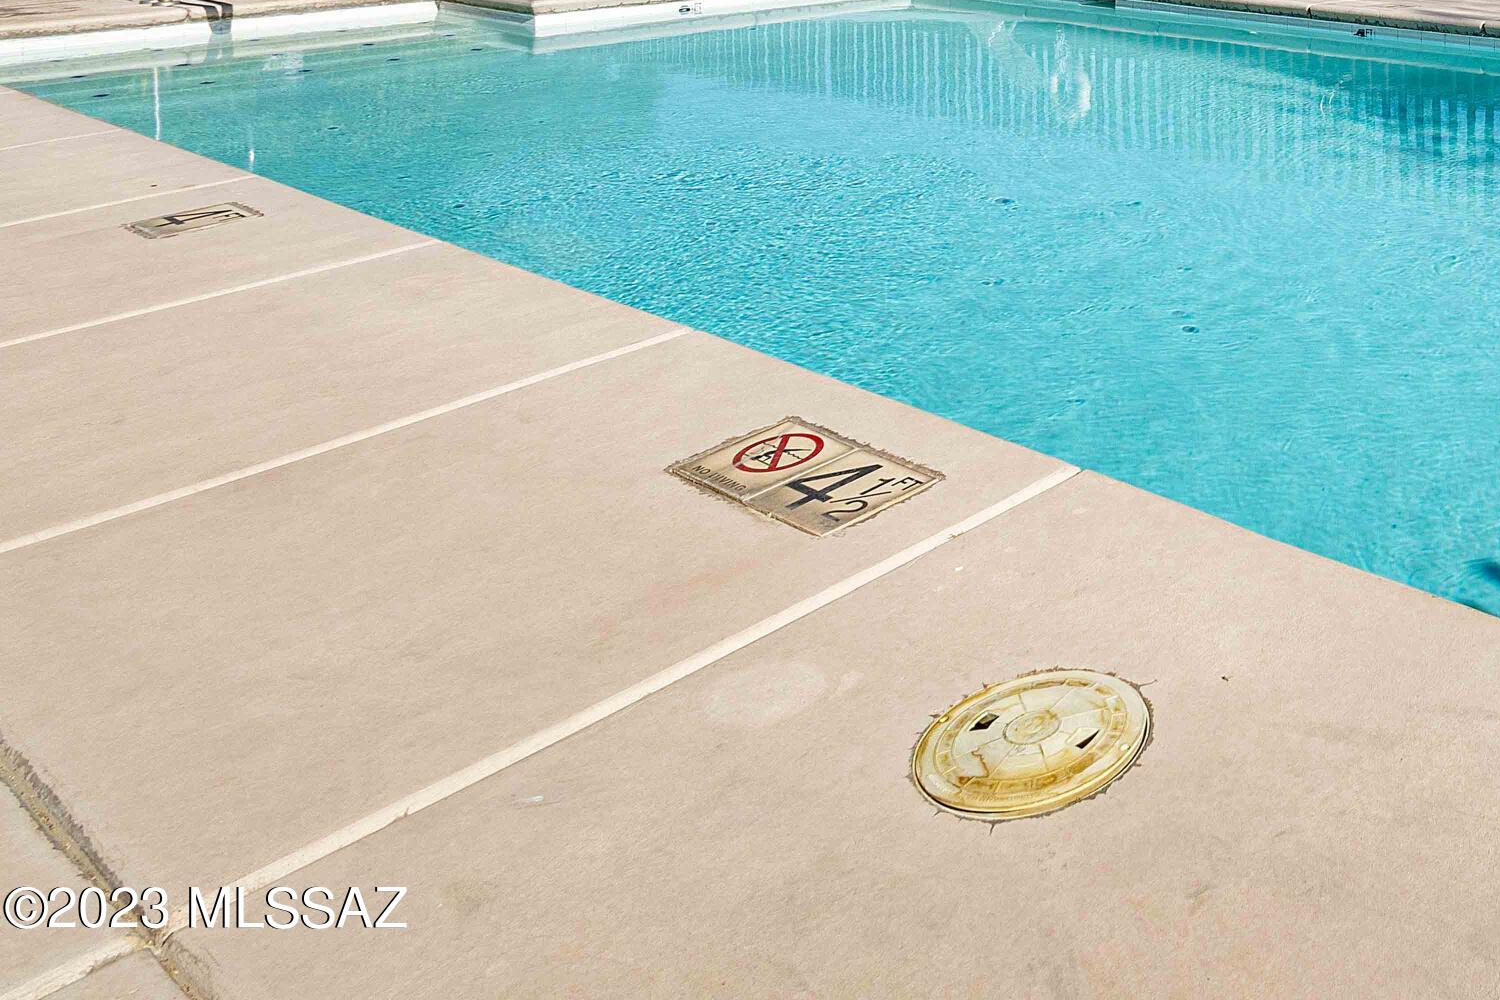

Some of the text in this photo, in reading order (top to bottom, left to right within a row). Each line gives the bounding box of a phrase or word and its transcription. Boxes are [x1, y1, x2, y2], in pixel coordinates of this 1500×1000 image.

[154, 210, 233, 228] 4
[692, 465, 747, 491] NO DIVING
[784, 464, 884, 510] 4
[891, 476, 924, 491] FT
